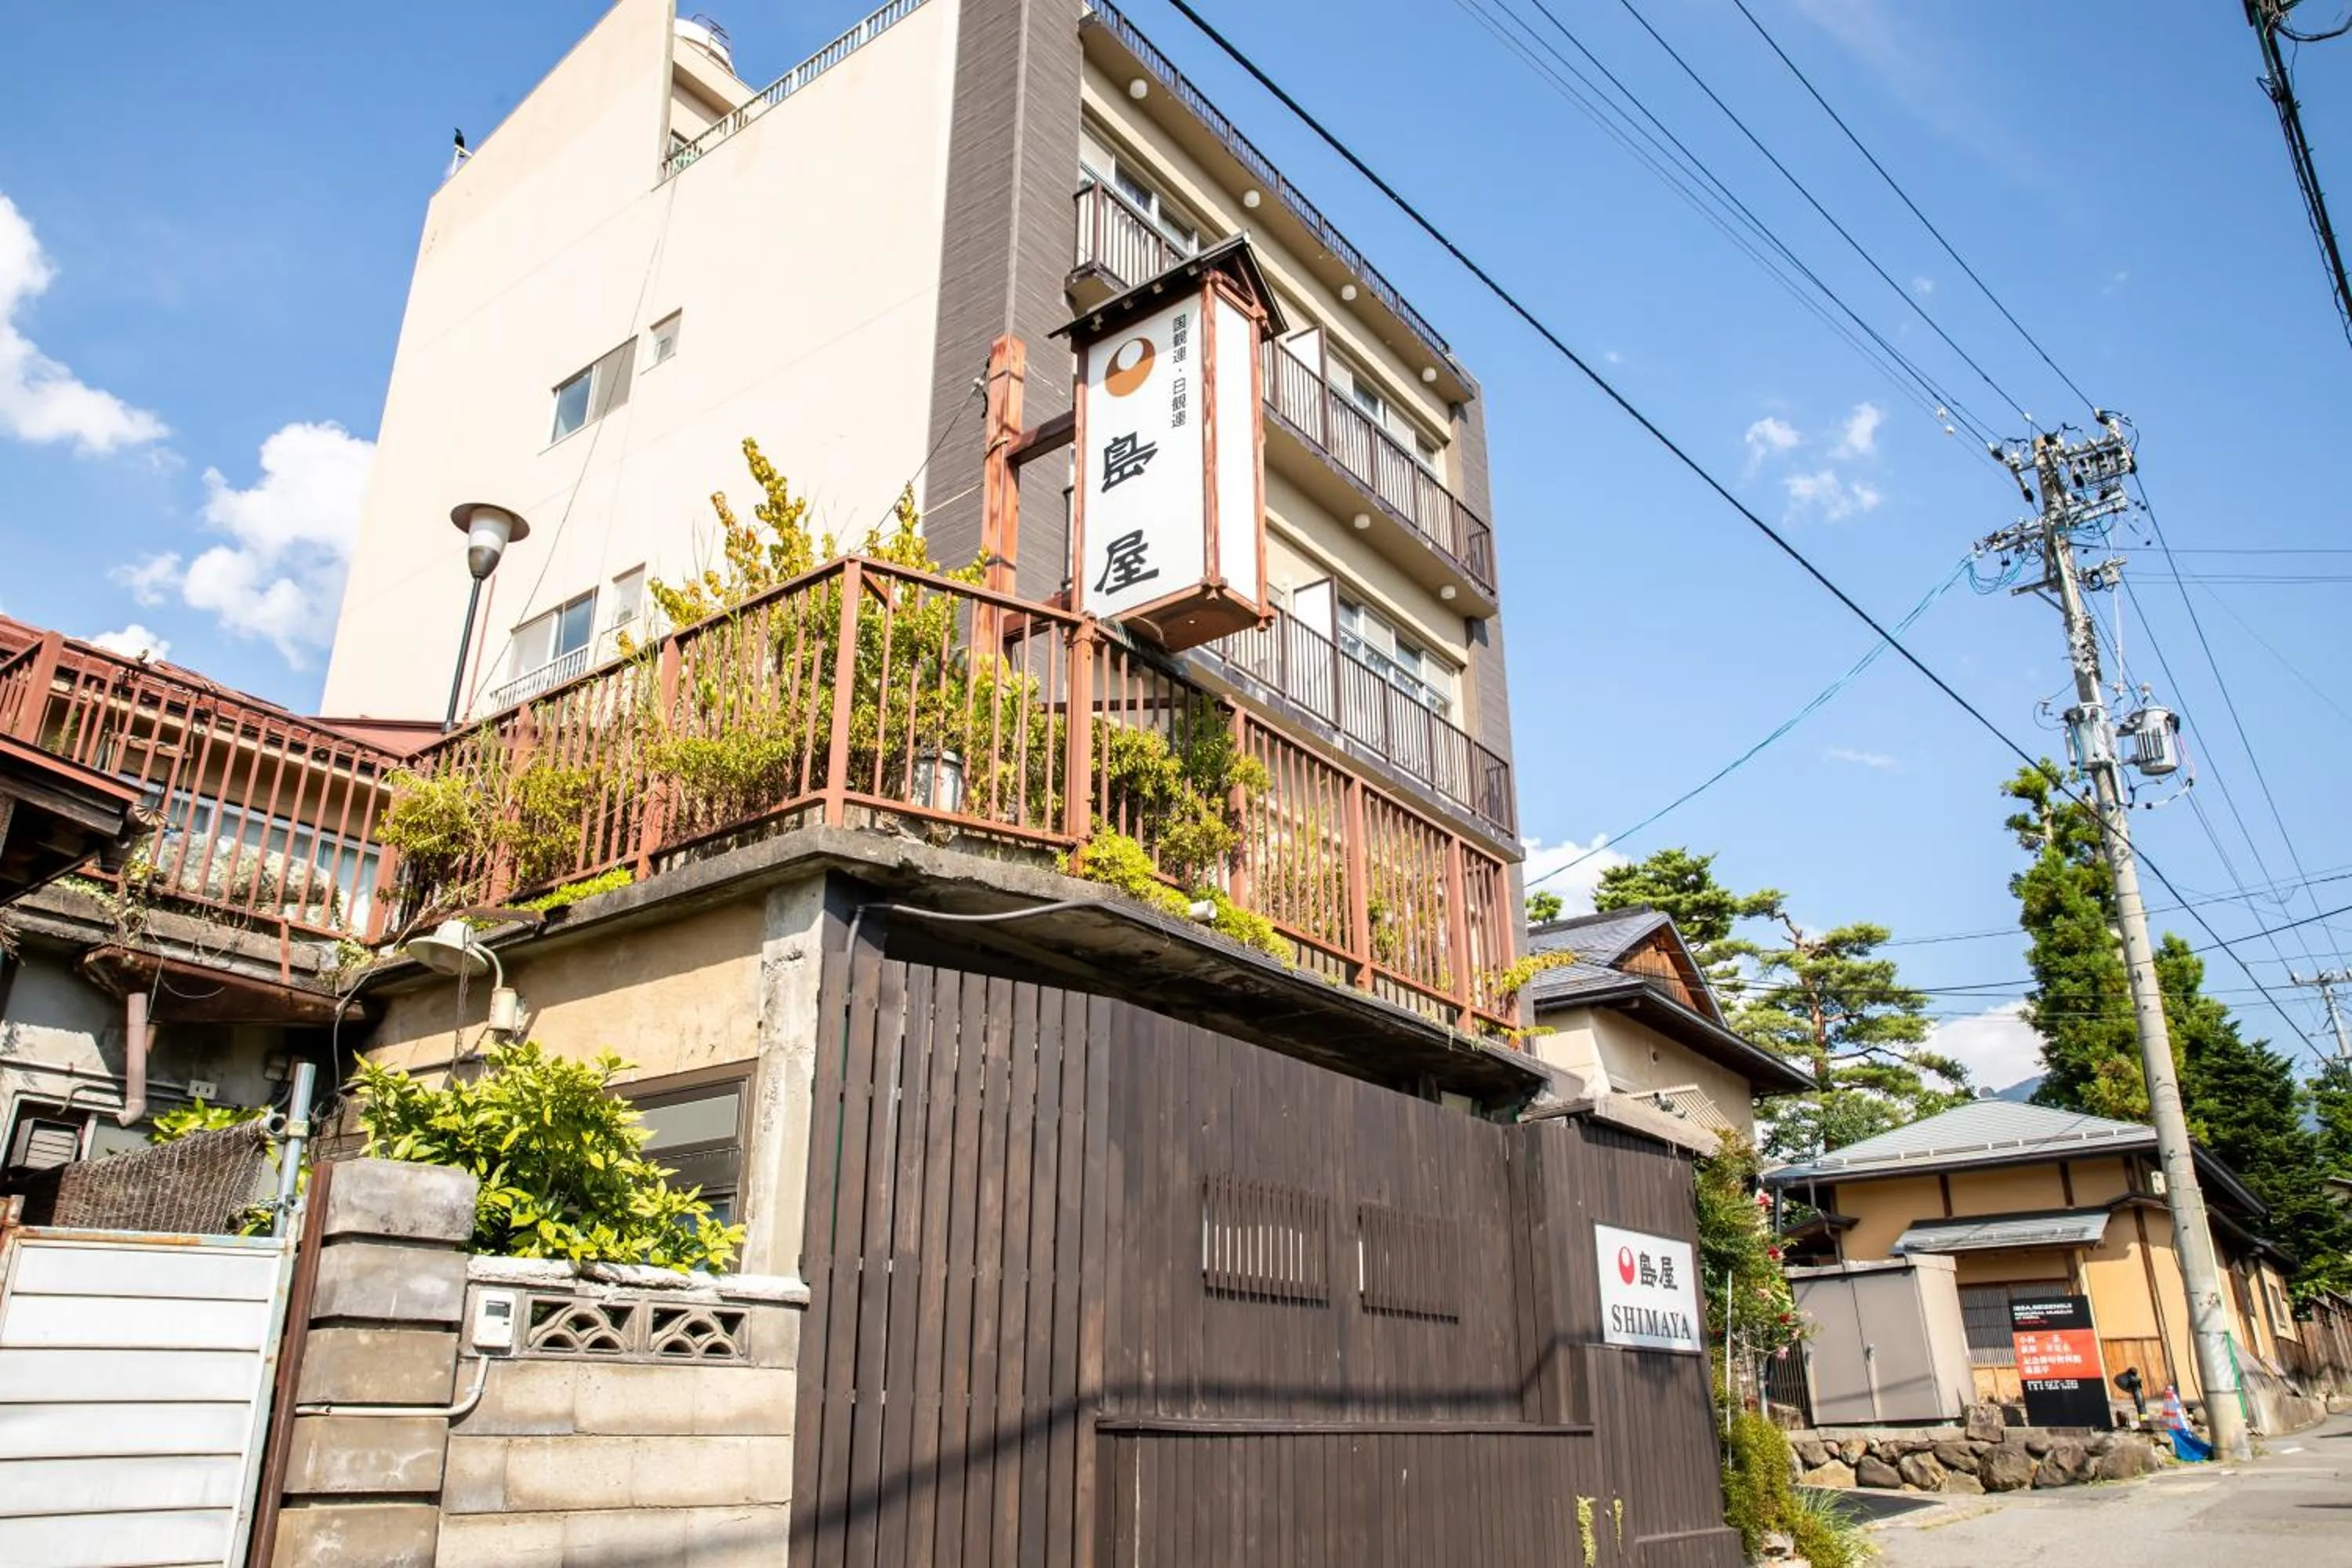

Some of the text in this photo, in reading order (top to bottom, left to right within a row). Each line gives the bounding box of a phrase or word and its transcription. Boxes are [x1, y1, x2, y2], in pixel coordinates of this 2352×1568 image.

[1094, 430, 1160, 596] 島屋
[1639, 1250, 1679, 1291] 島屋
[1611, 1303, 1691, 1340] SHIMAYA
